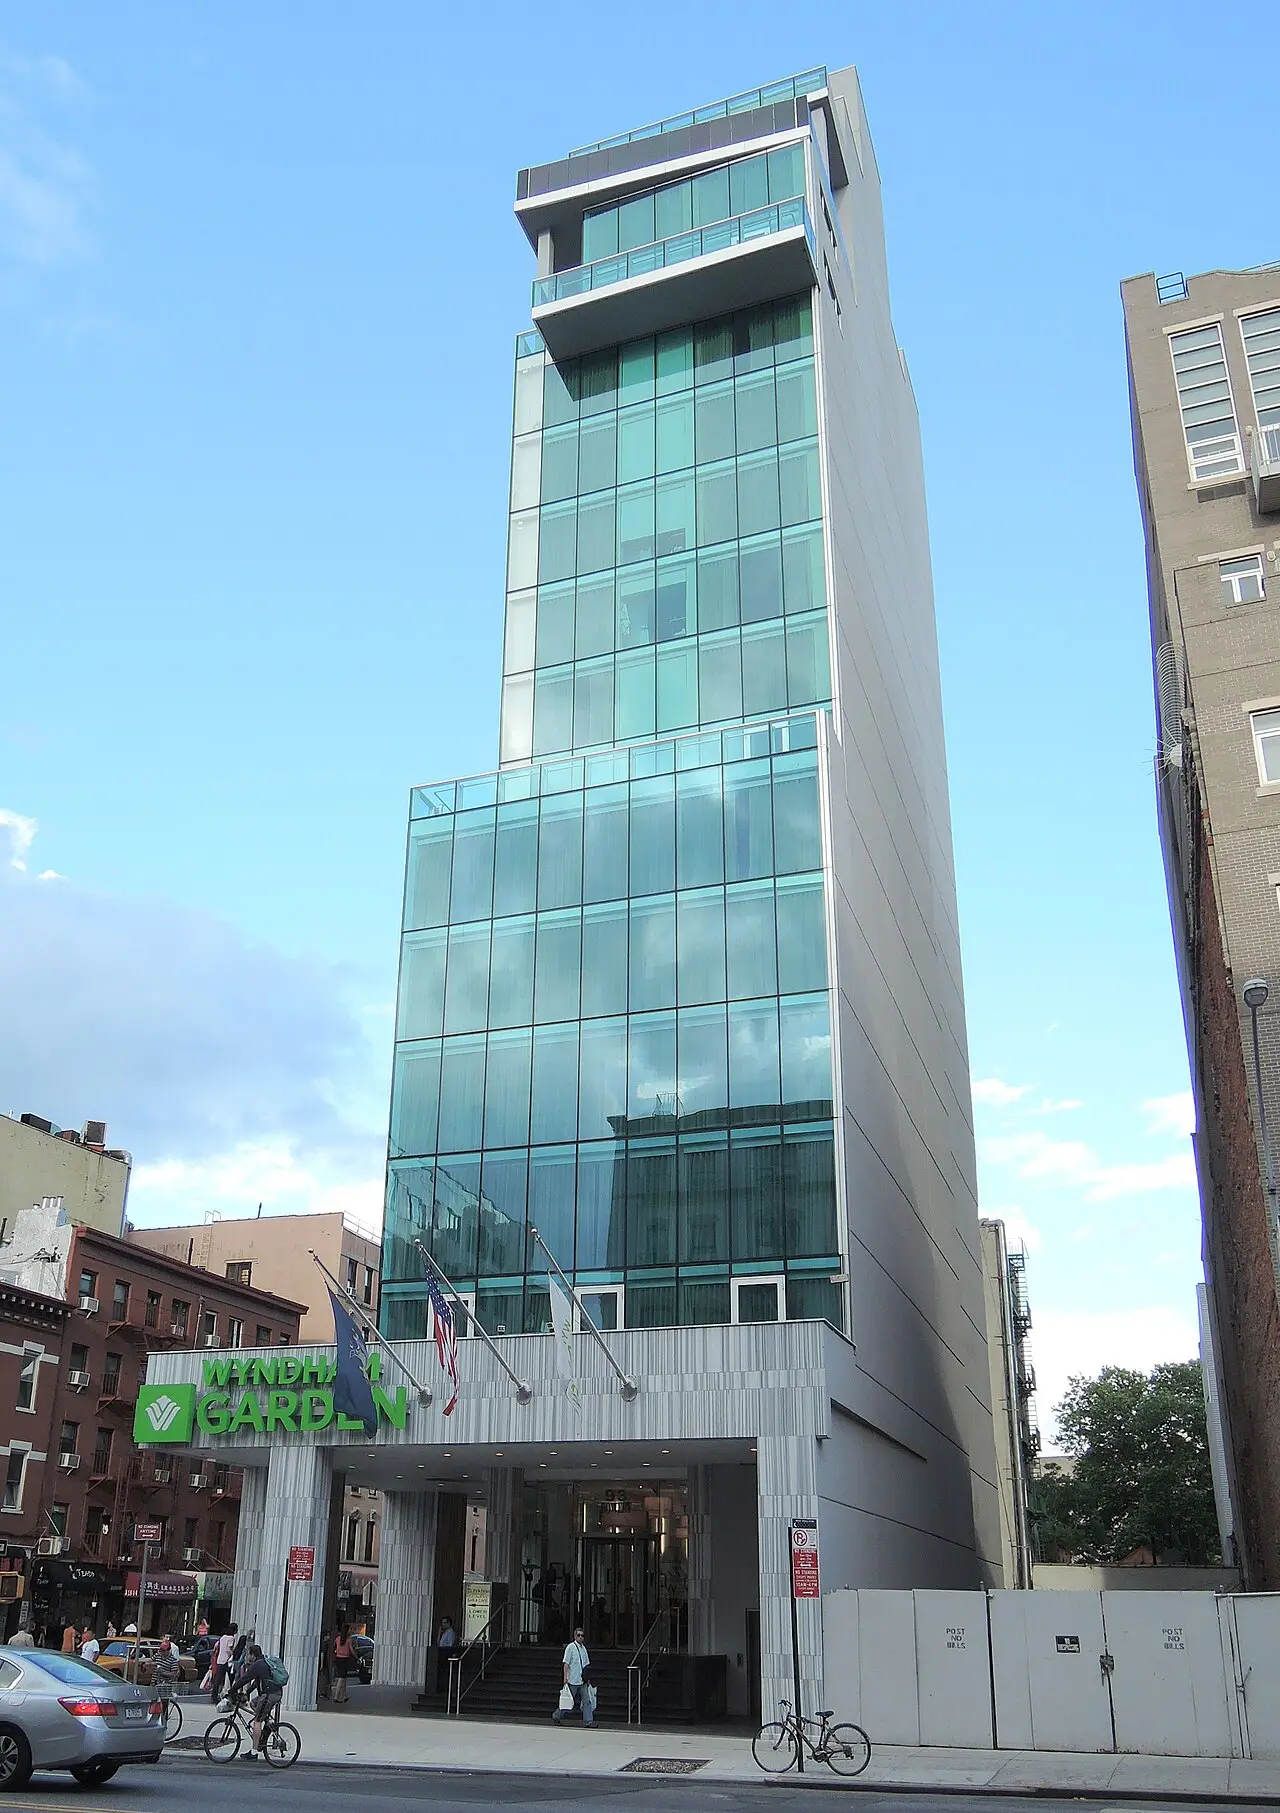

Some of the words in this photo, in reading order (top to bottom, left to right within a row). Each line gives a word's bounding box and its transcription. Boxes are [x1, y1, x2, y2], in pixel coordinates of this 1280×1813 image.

[202, 1353, 381, 1386] WYNDH
[606, 1489, 628, 1501] 93
[1164, 1642, 1185, 1650] BILLS
